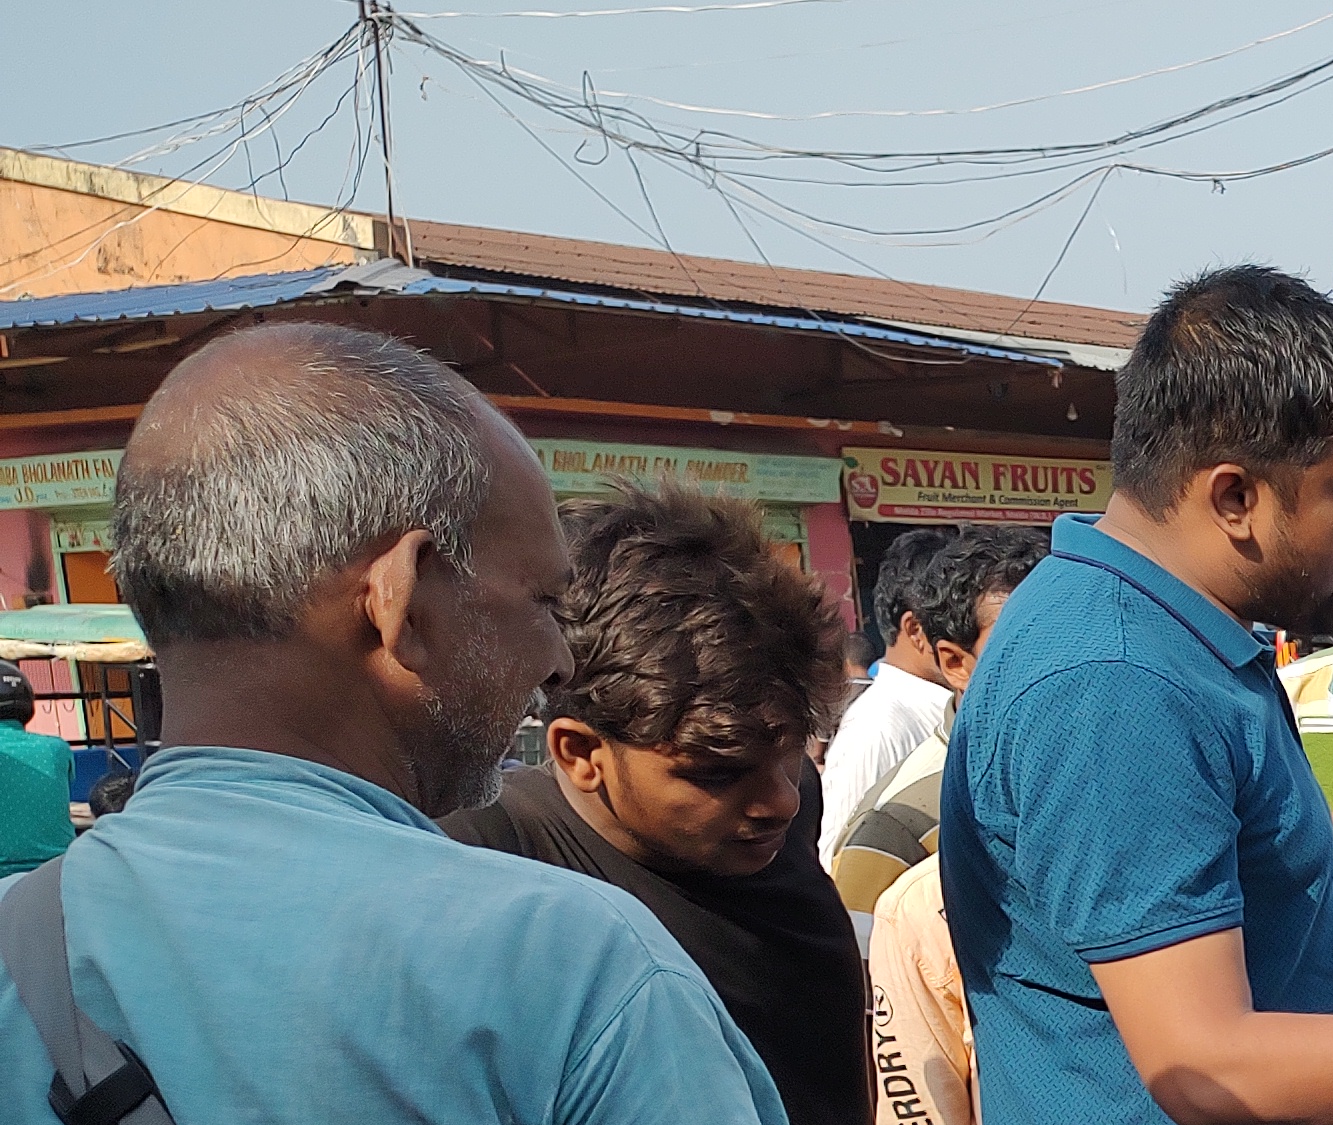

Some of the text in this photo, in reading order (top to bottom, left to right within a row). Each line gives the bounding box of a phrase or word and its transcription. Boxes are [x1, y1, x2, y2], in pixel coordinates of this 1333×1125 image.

[22, 458, 91, 484] BHOLANATH
[552, 449, 648, 474] BHOLANATH
[881, 457, 980, 490] SAYAN
[991, 463, 1097, 494] FRUITS
[917, 491, 1078, 509] Fruit Merchant & Commission Agent
